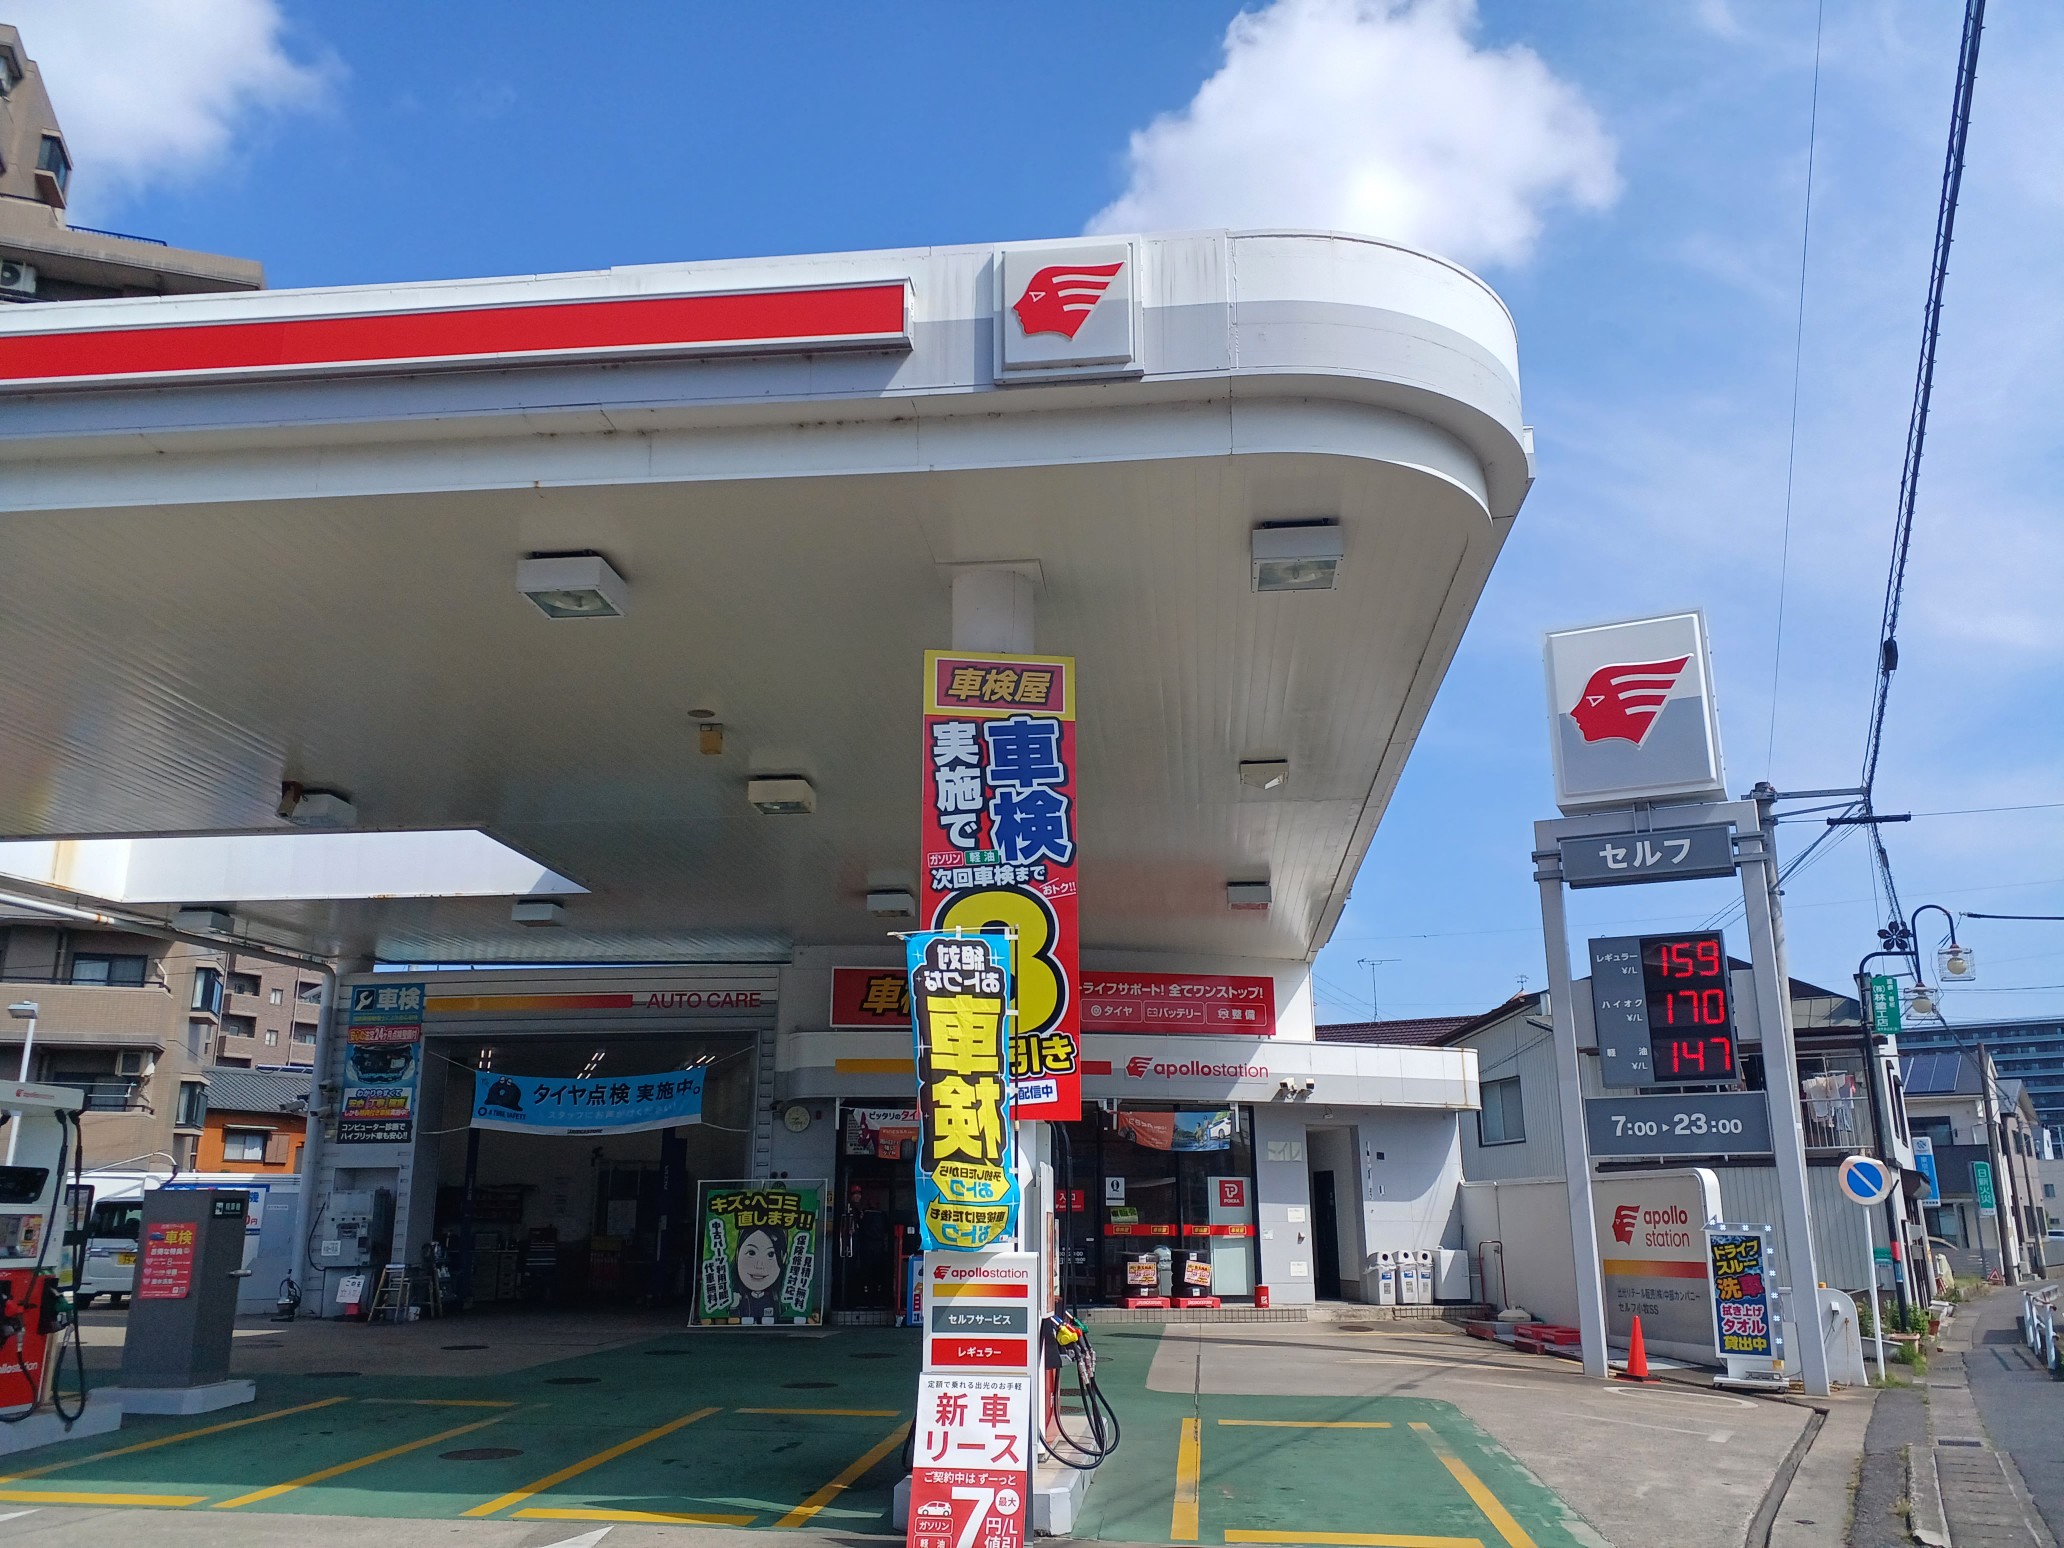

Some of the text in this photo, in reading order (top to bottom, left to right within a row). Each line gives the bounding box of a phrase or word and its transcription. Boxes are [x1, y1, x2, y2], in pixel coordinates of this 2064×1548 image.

[947, 668, 1052, 703] 車検屋
[932, 721, 983, 848] 実施で
[986, 717, 1072, 864] 車検
[929, 853, 962, 866] ガソリン
[1599, 838, 1691, 869] セルフ
[931, 865, 1045, 889] 次回車検まで
[1596, 952, 1638, 963] レギュラー
[1661, 940, 1719, 979] 159
[376, 987, 421, 1011] 車検
[863, 977, 911, 1014] 車
[1079, 982, 1264, 999] ライフサポート! 全てワンストップ!
[647, 992, 761, 1009] AUTO CARE
[1601, 999, 1643, 1009] ハイオク
[1667, 988, 1725, 1025] 170
[1104, 1005, 1256, 1021] タイヤ バッテリー 整備
[1673, 1037, 1732, 1073] 147
[1153, 1060, 1269, 1079] apollostation
[533, 1083, 631, 1106] タイヤ点検
[1611, 1113, 1743, 1137] 7:00 23:00
[711, 1194, 799, 1213] キズ・ヘコミ
[737, 1210, 813, 1228] 直します!!
[1643, 1205, 1689, 1230] apollo
[164, 1230, 193, 1245] 車検
[1645, 1229, 1691, 1248] station
[1713, 1241, 1758, 1260] ドライブ
[951, 1266, 1029, 1281] apollostation
[1717, 1260, 1757, 1276] スルー
[1716, 1274, 1765, 1300] 洗車
[948, 1314, 1012, 1326] セルフサービス
[1722, 1303, 1763, 1318] 拭き上げ
[1723, 1319, 1767, 1335] タオル
[957, 1346, 1002, 1358] レギュラー
[1724, 1335, 1768, 1352] 貸出中
[927, 1380, 1022, 1391] 定額で乗れる出光のお手軽
[935, 1392, 1011, 1429] 新車
[926, 1431, 1020, 1465] リース
[998, 1497, 1017, 1507] 最大
[918, 1521, 950, 1531] ガソリン
[951, 1486, 995, 1548] 7
[985, 1518, 1018, 1535] 円/L
